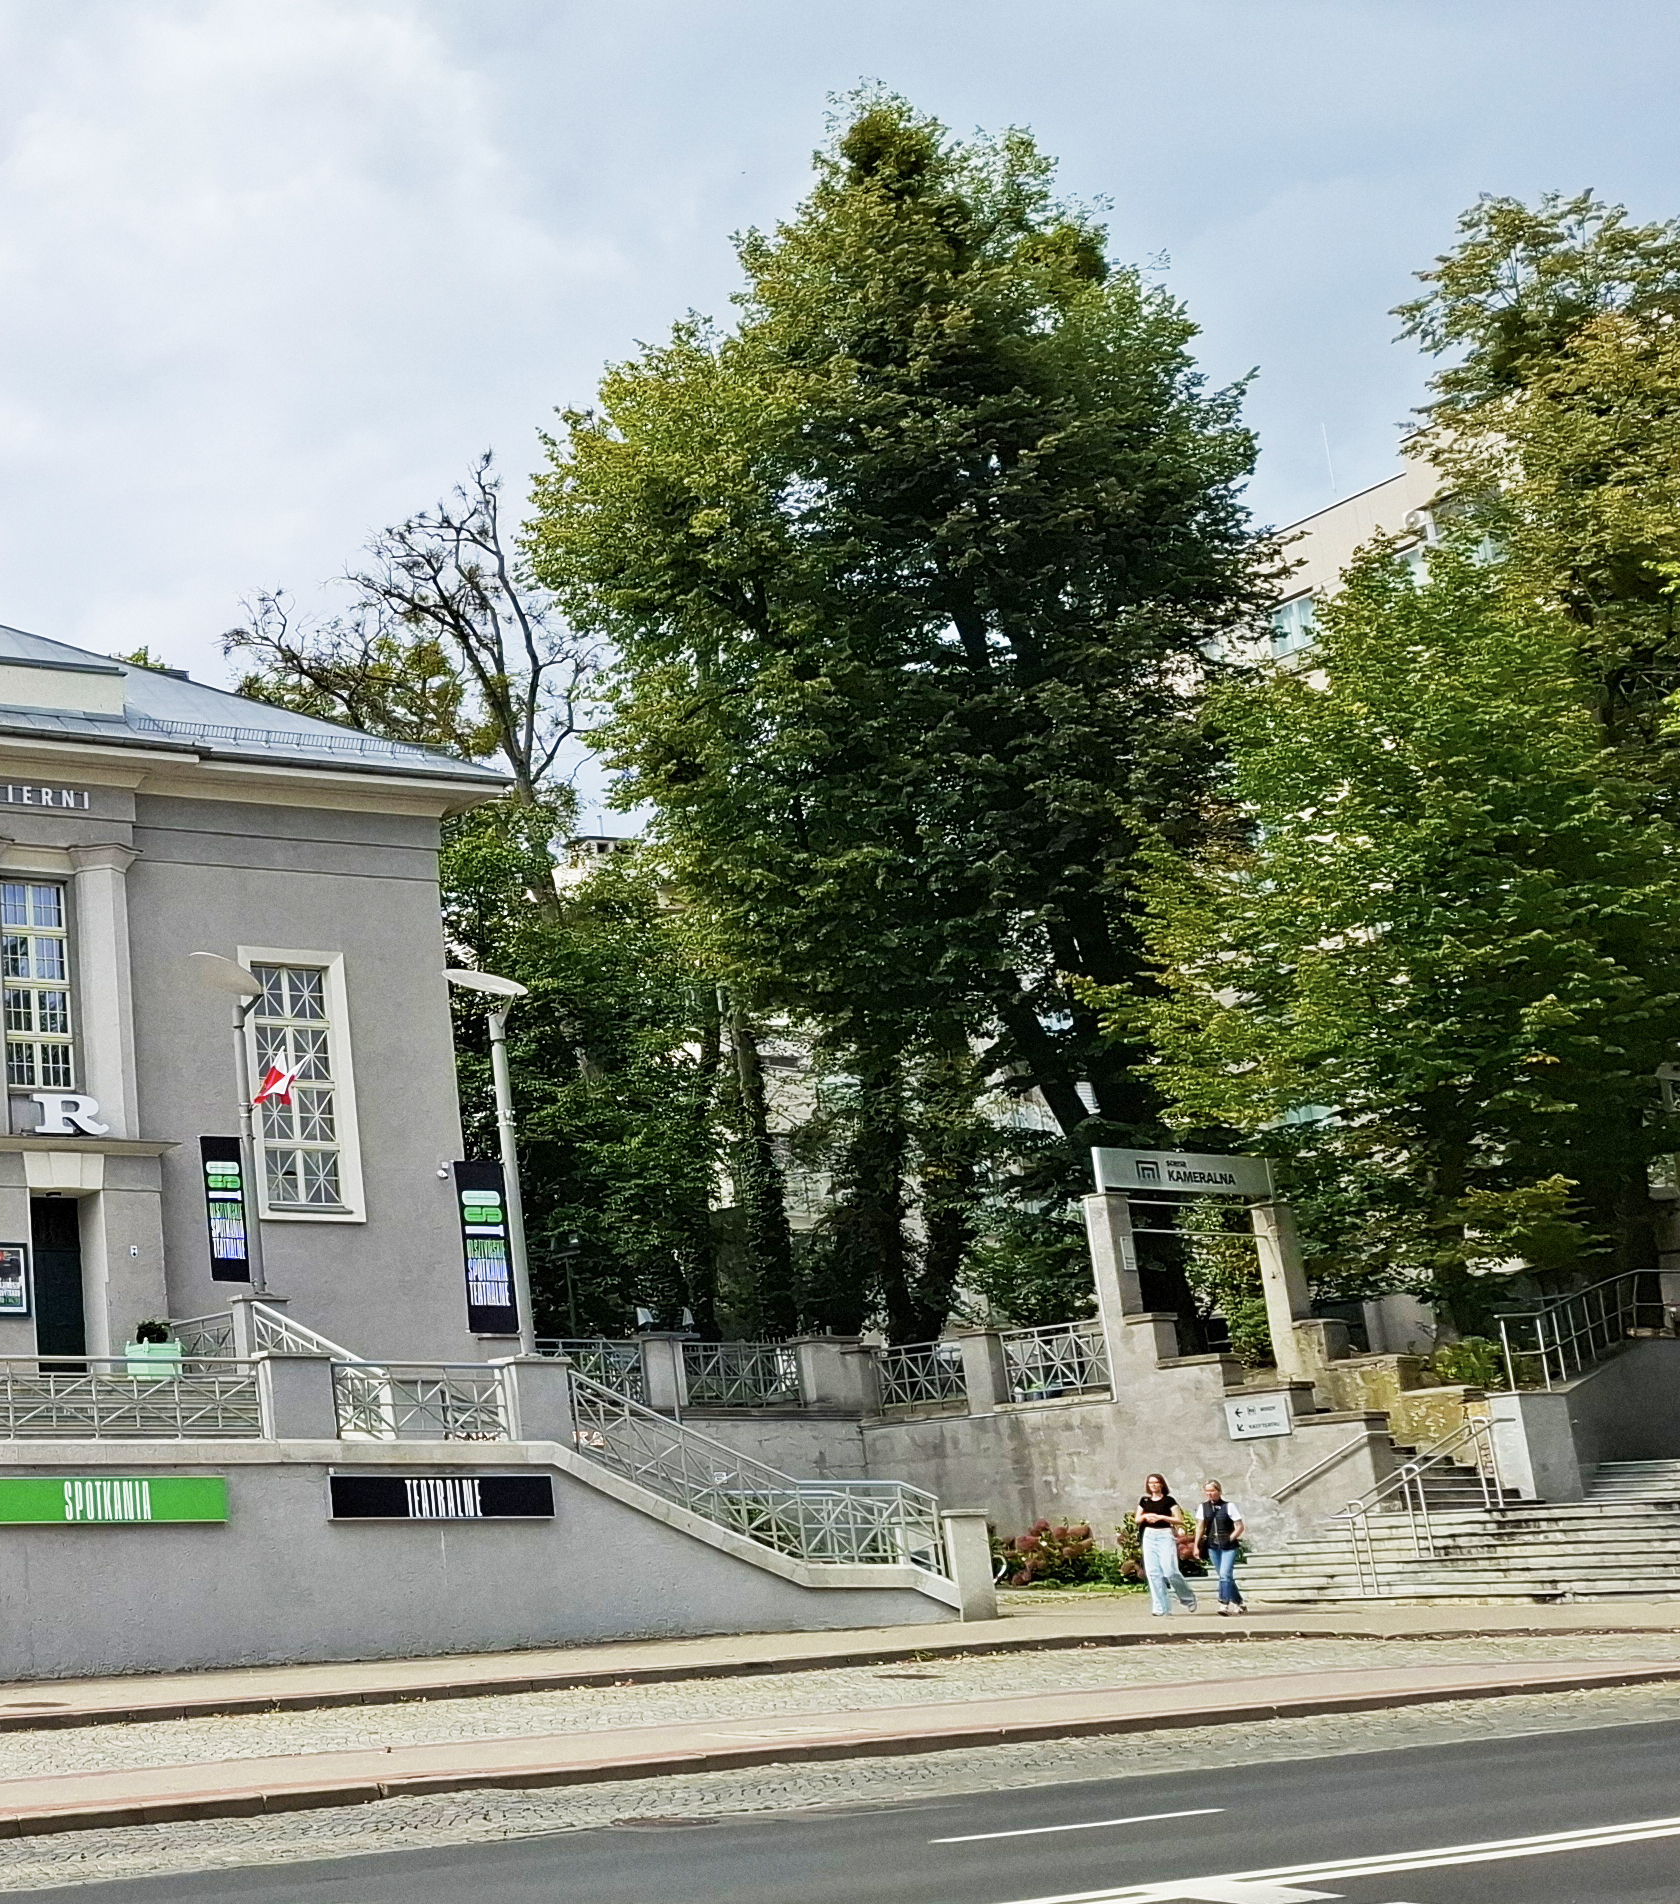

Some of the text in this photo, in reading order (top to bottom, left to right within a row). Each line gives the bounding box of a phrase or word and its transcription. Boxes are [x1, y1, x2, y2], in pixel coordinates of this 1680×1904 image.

[1167, 1170, 1236, 1185] KAMERALNA
[64, 1481, 152, 1520] SPOTKANIA
[404, 1479, 482, 1517] TEATRALNE
